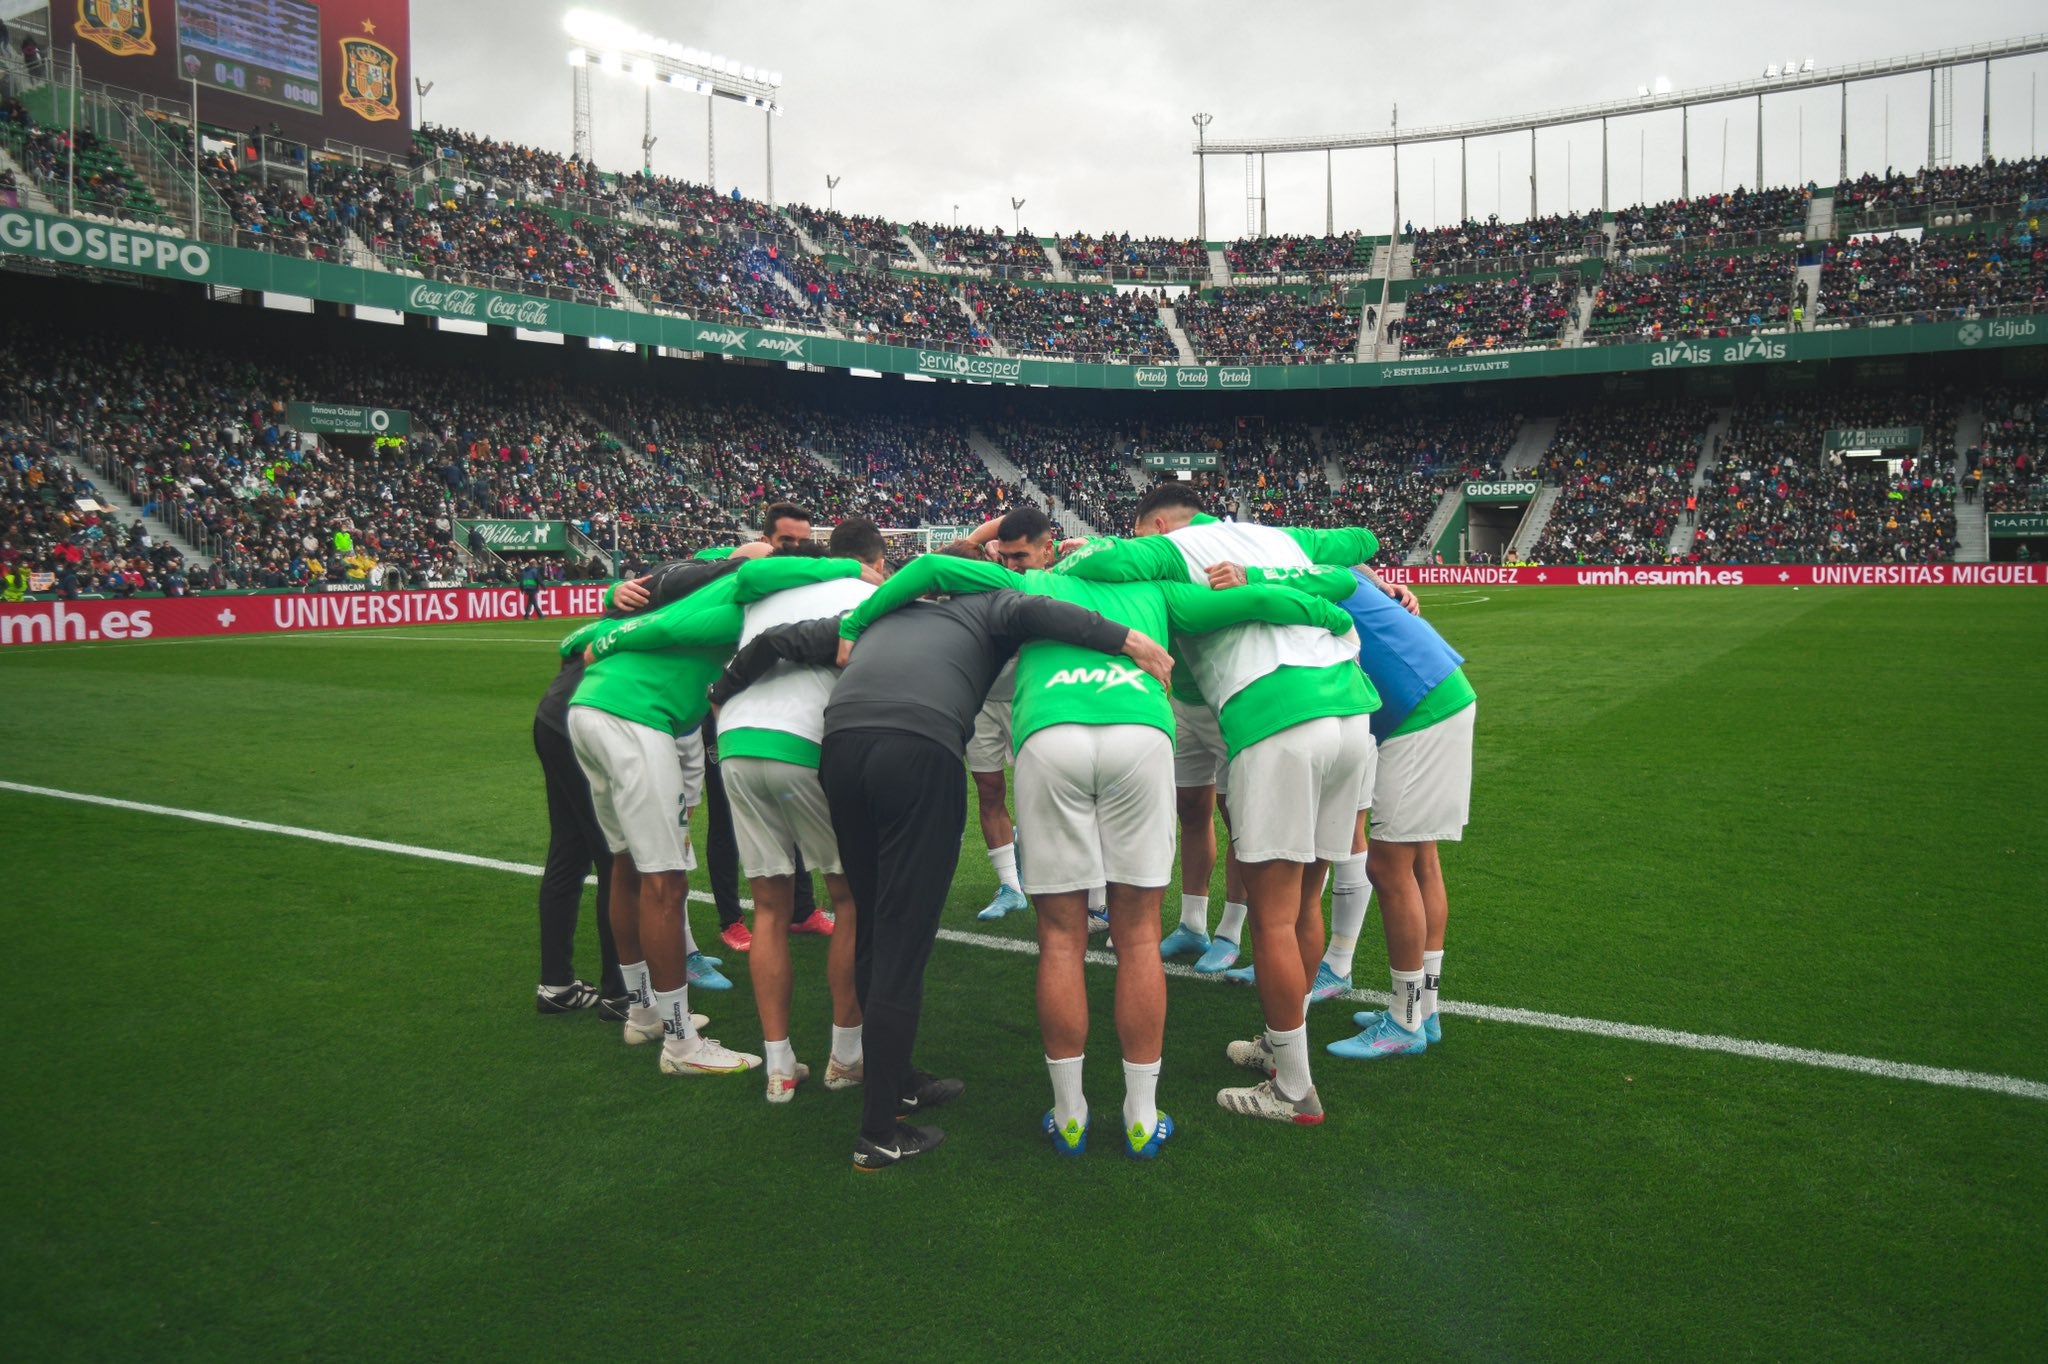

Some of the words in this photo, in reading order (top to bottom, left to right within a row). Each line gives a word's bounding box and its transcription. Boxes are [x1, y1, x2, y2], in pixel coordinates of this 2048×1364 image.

[0, 213, 210, 276] GIOSEPPO
[697, 328, 750, 351] AMIX
[757, 336, 807, 358] AMIX
[1393, 365, 1450, 377] ESTRELLA
[1458, 360, 1510, 373] LEVANTE
[312, 406, 337, 415] Innova
[337, 407, 362, 417] Ocular
[1467, 482, 1536, 496] GIOSEPPO
[1994, 518, 2048, 528] MARTI
[1419, 566, 1518, 584] HERNÁNDEZ
[1812, 565, 1945, 584] UNIVERSITAS
[1952, 566, 2038, 584] MIGUEL
[327, 583, 365, 592] #FANCAM
[429, 580, 462, 588] #FANCAM
[274, 592, 459, 629] UNIVERSITAS
[0, 602, 153, 644] mh.es
[1045, 662, 1149, 694] AMIX
